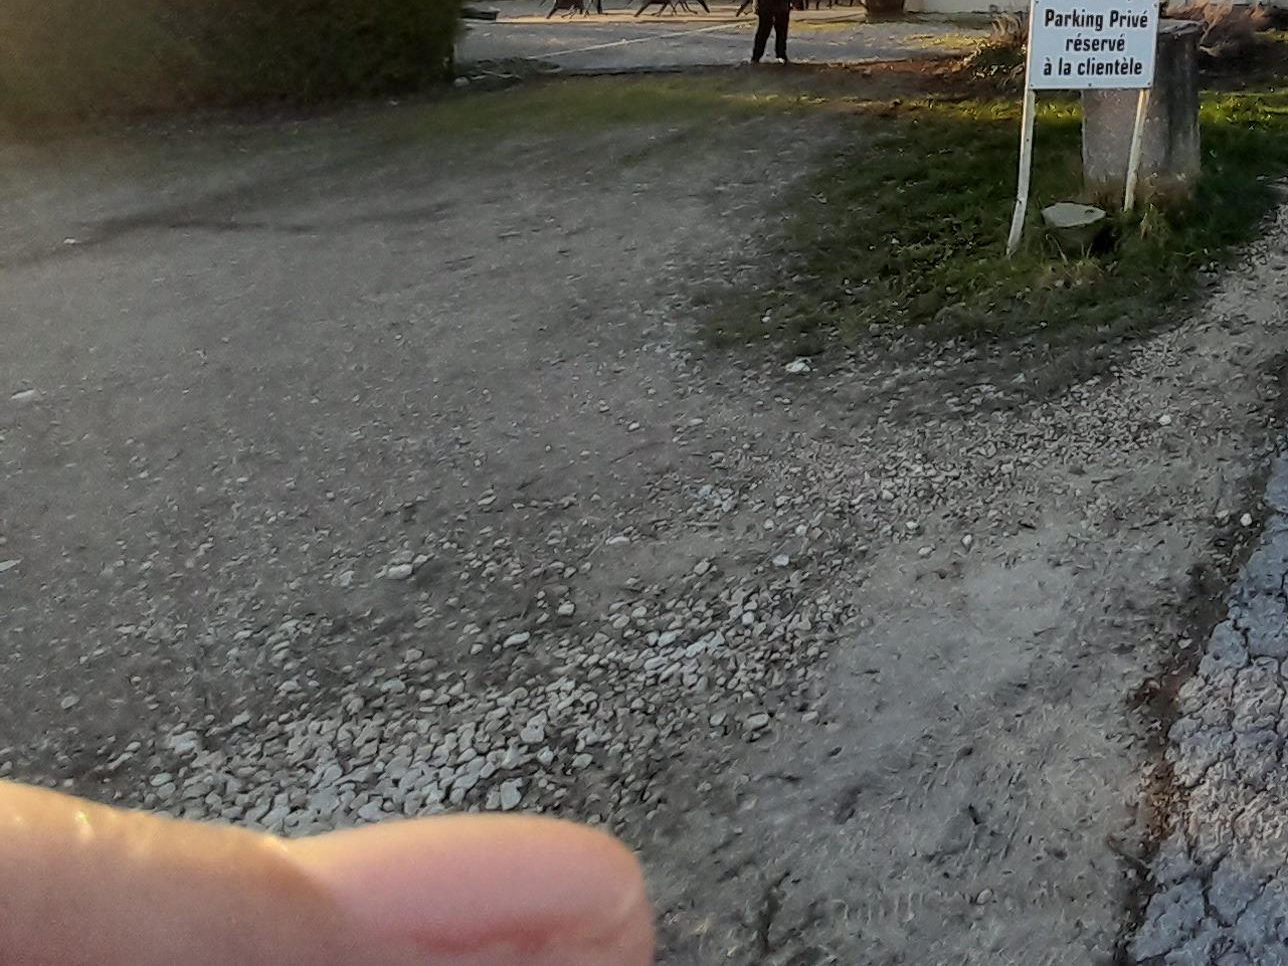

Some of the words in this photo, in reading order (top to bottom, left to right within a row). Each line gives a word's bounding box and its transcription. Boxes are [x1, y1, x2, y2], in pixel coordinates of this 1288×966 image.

[1044, 9, 1104, 32] Parking
[1109, 10, 1148, 28] Privé
[1065, 33, 1125, 52] réservé
[1043, 57, 1052, 76] à
[1058, 57, 1072, 76] la
[1077, 57, 1142, 76] clientèle
